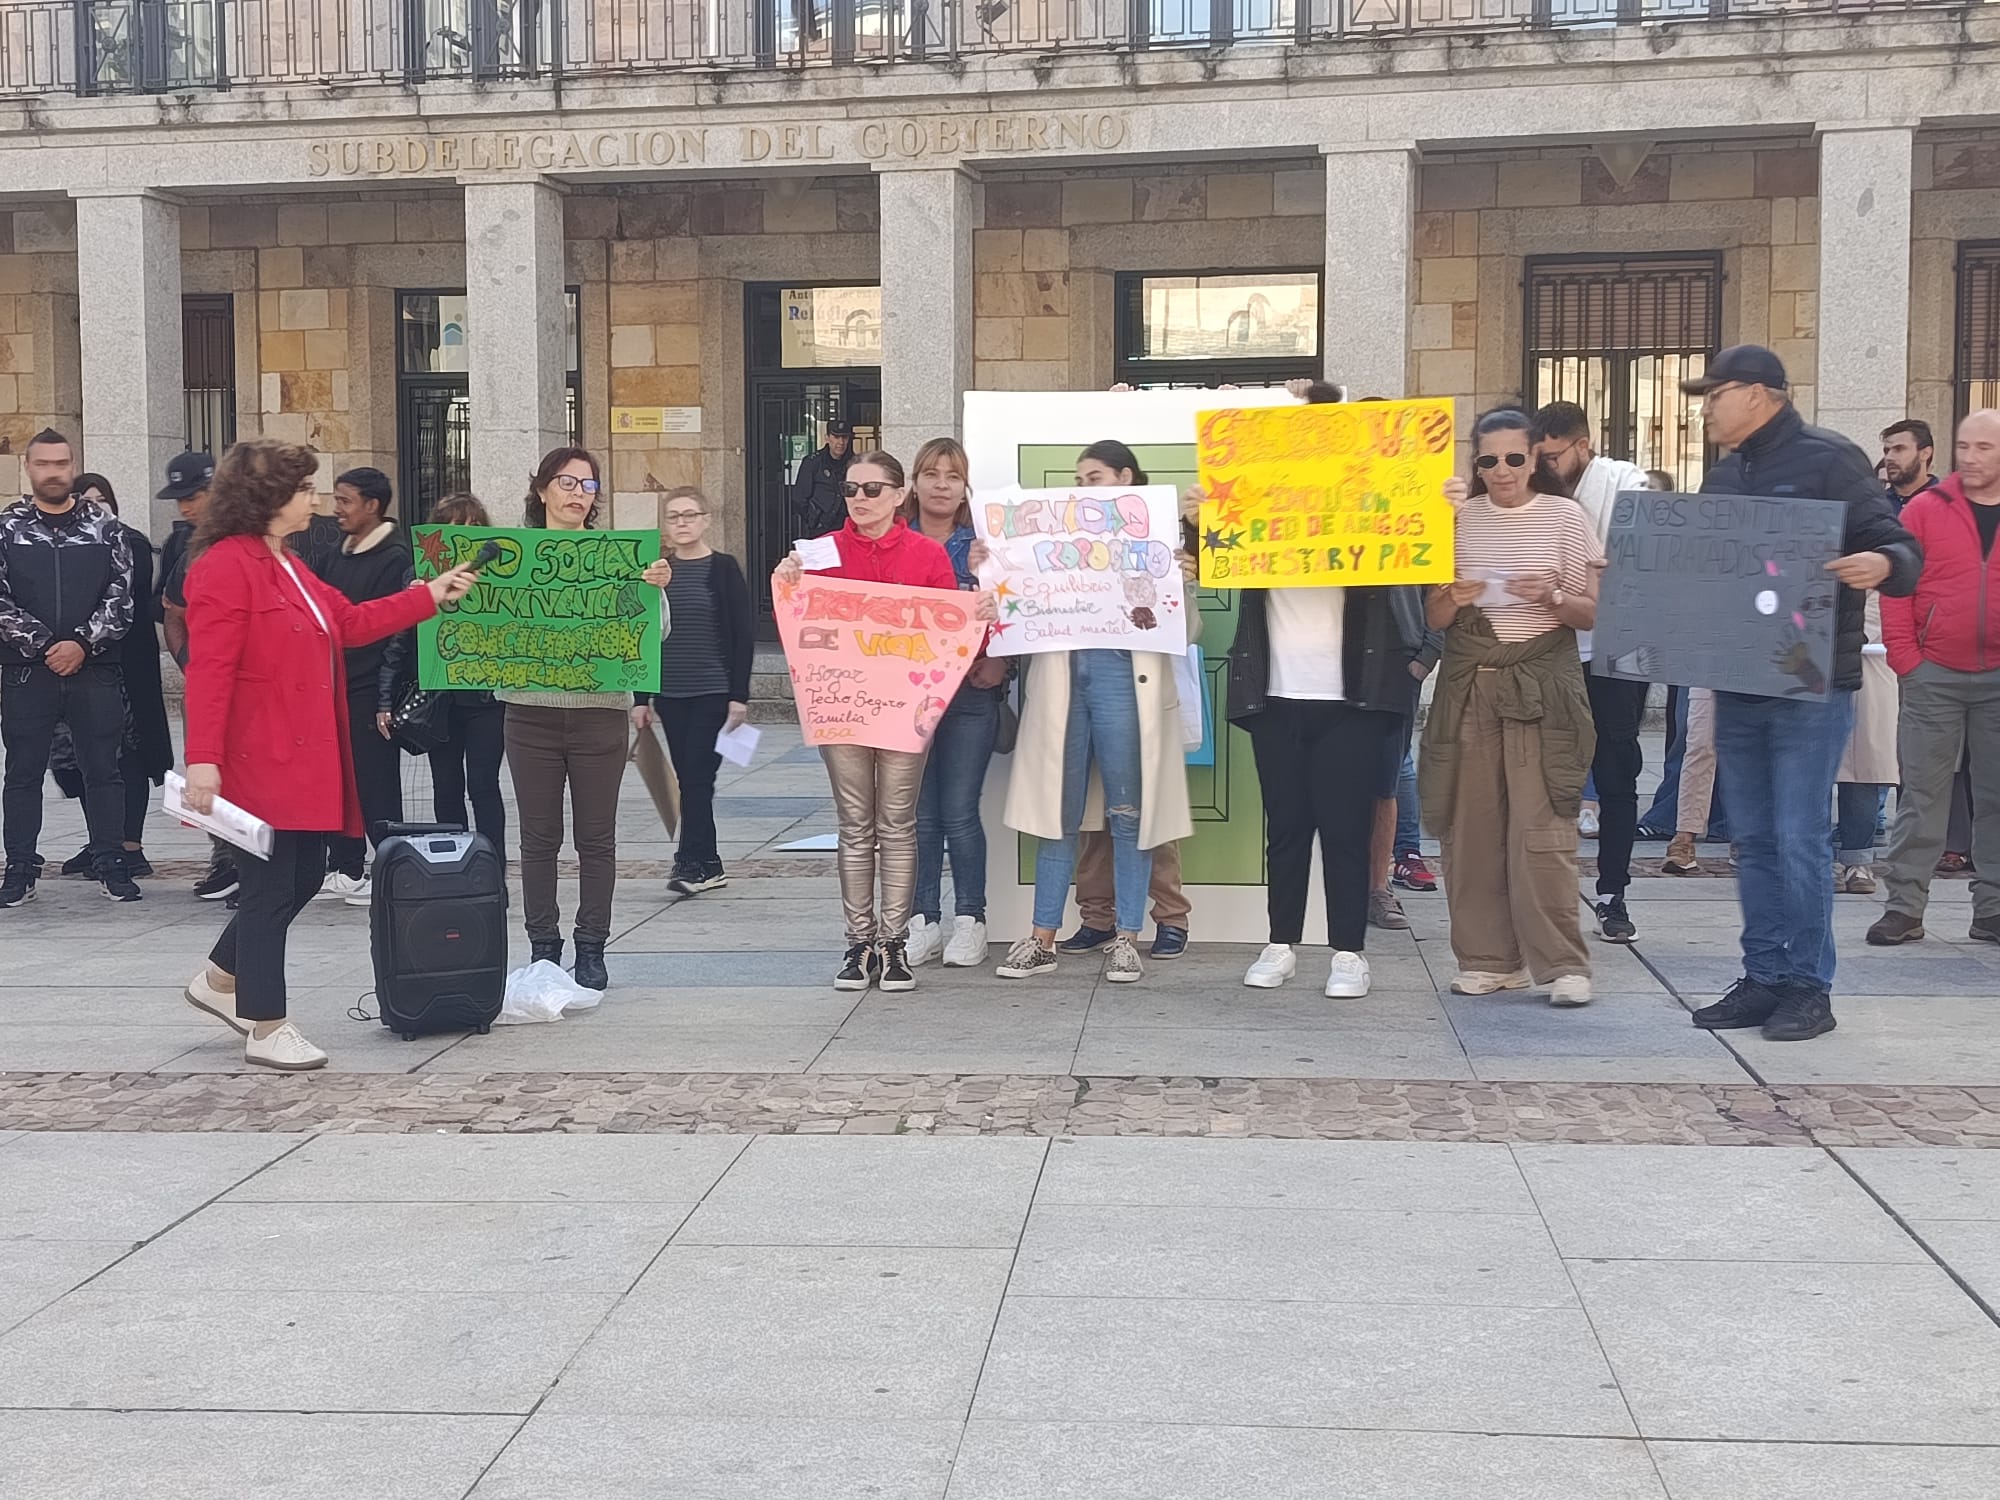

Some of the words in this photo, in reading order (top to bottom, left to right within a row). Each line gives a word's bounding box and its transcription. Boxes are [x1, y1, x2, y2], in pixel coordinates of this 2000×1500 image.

[308, 128, 709, 177] SUBDELEGACION
[740, 124, 835, 161] DEL
[855, 114, 1126, 159] GOBIERNO
[985, 494, 1149, 539] DIGNIDAD
[1250, 516, 1299, 543] RED
[1307, 514, 1335, 538] DE
[1343, 512, 1425, 537] AMIGOS
[531, 535, 648, 585] SOCIAL
[1211, 546, 1344, 579] BIENESTAR
[1348, 545, 1366, 571] Y
[1378, 542, 1433, 572] PAZ
[799, 626, 839, 650] DE
[853, 630, 938, 665] VIDA
[1024, 620, 1073, 641] Salud
[1080, 619, 1134, 635] mental
[446, 658, 604, 692] FAMILIAR
[805, 663, 868, 694] Hogar
[805, 687, 851, 705] Techo
[806, 705, 870, 726] Familia
